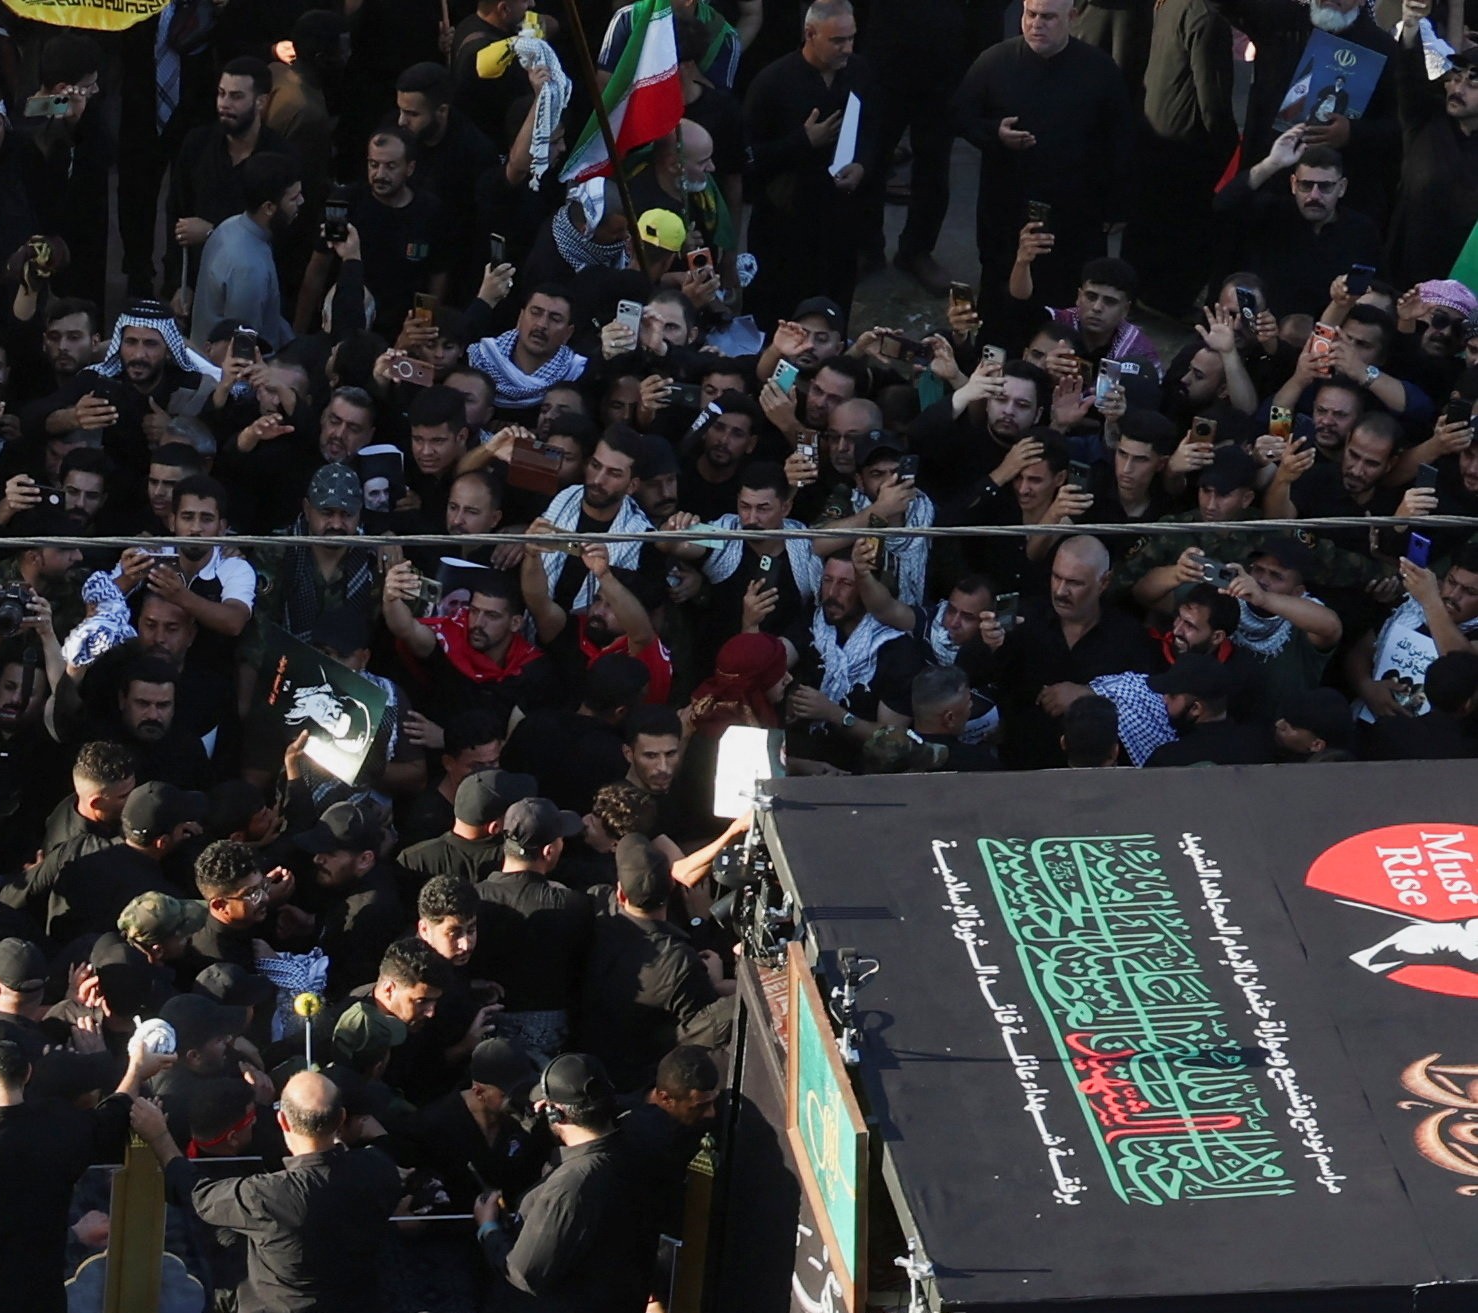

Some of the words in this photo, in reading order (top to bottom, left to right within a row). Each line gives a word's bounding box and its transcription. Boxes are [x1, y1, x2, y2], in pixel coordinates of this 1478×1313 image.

[1375, 845, 1428, 907] Rise
[1420, 830, 1478, 906] Must
[1305, 1154, 1346, 1193] مراسم
